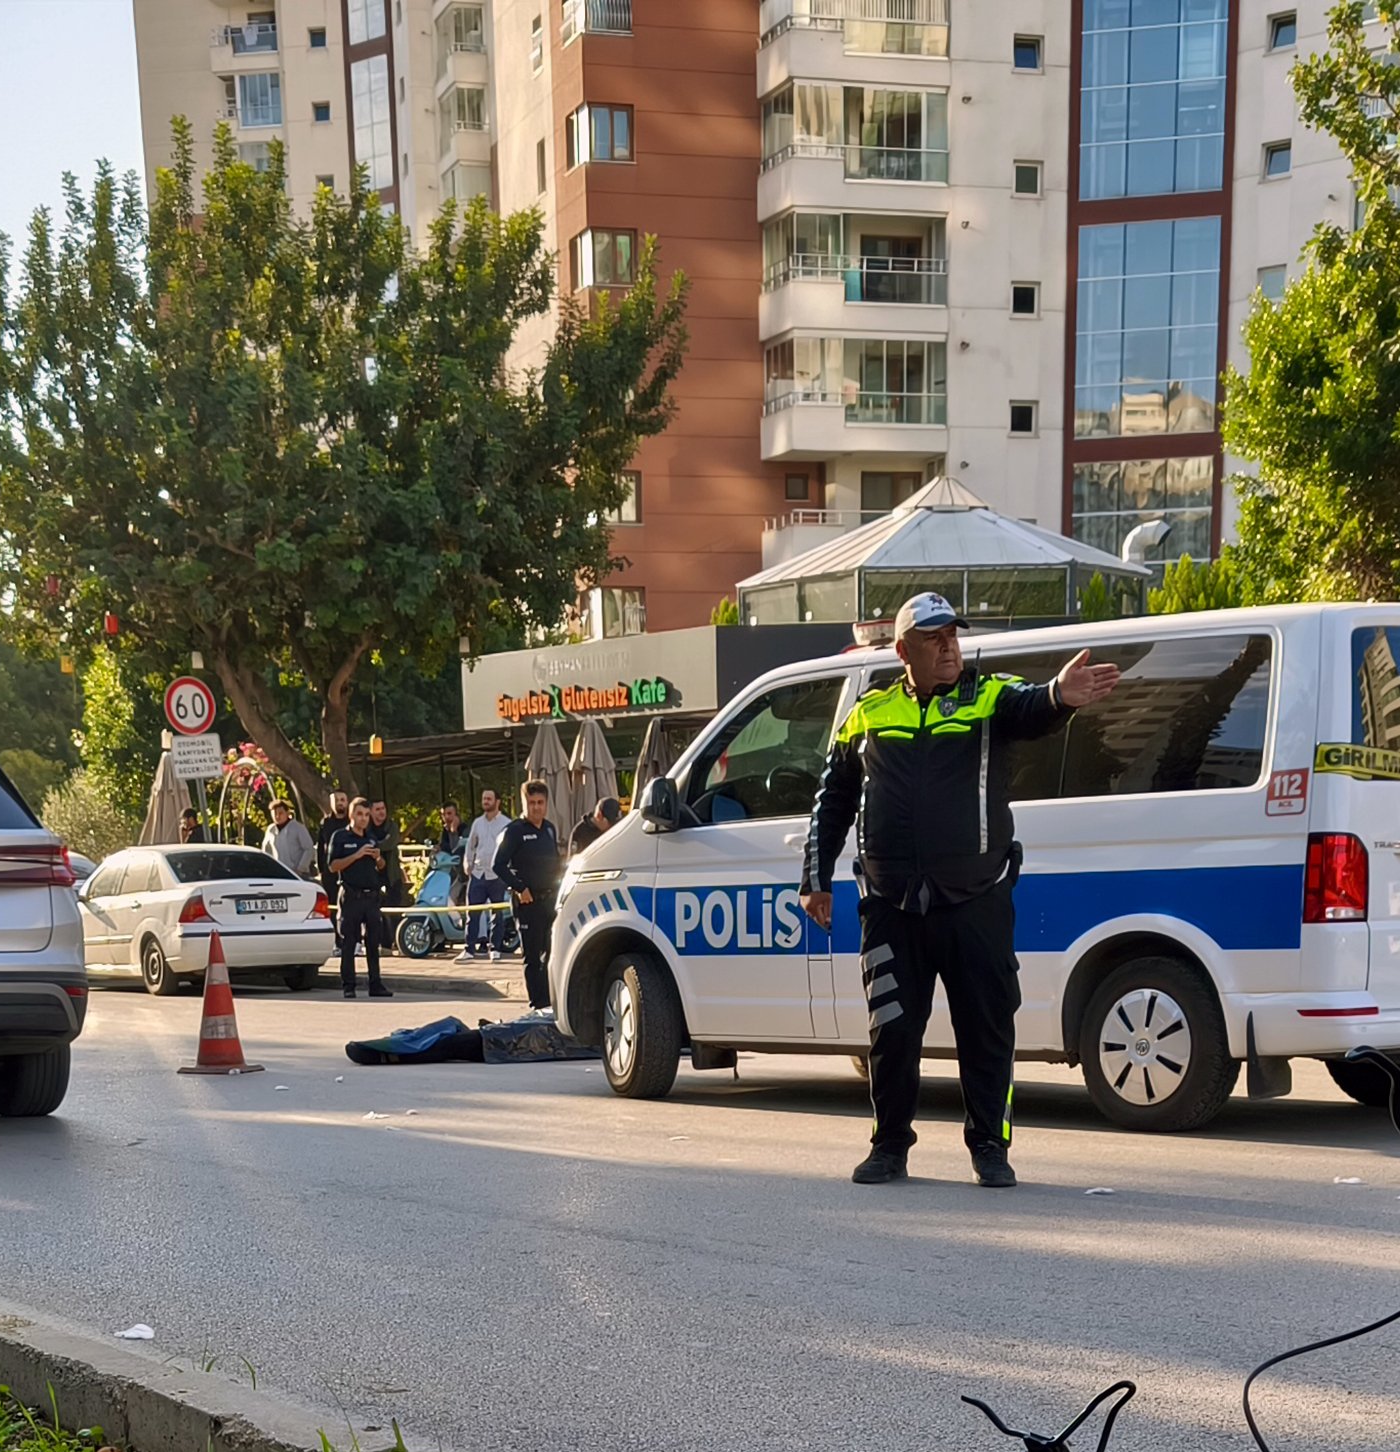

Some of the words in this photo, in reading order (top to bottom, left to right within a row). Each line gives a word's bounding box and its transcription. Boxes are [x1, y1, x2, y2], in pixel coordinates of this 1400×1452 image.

[176, 693, 205, 719] 60
[496, 691, 550, 722] Engelsiz
[561, 683, 629, 711] Glutensiz
[631, 678, 666, 705] Kafe
[1274, 773, 1302, 797] 112
[242, 901, 251, 910] 01
